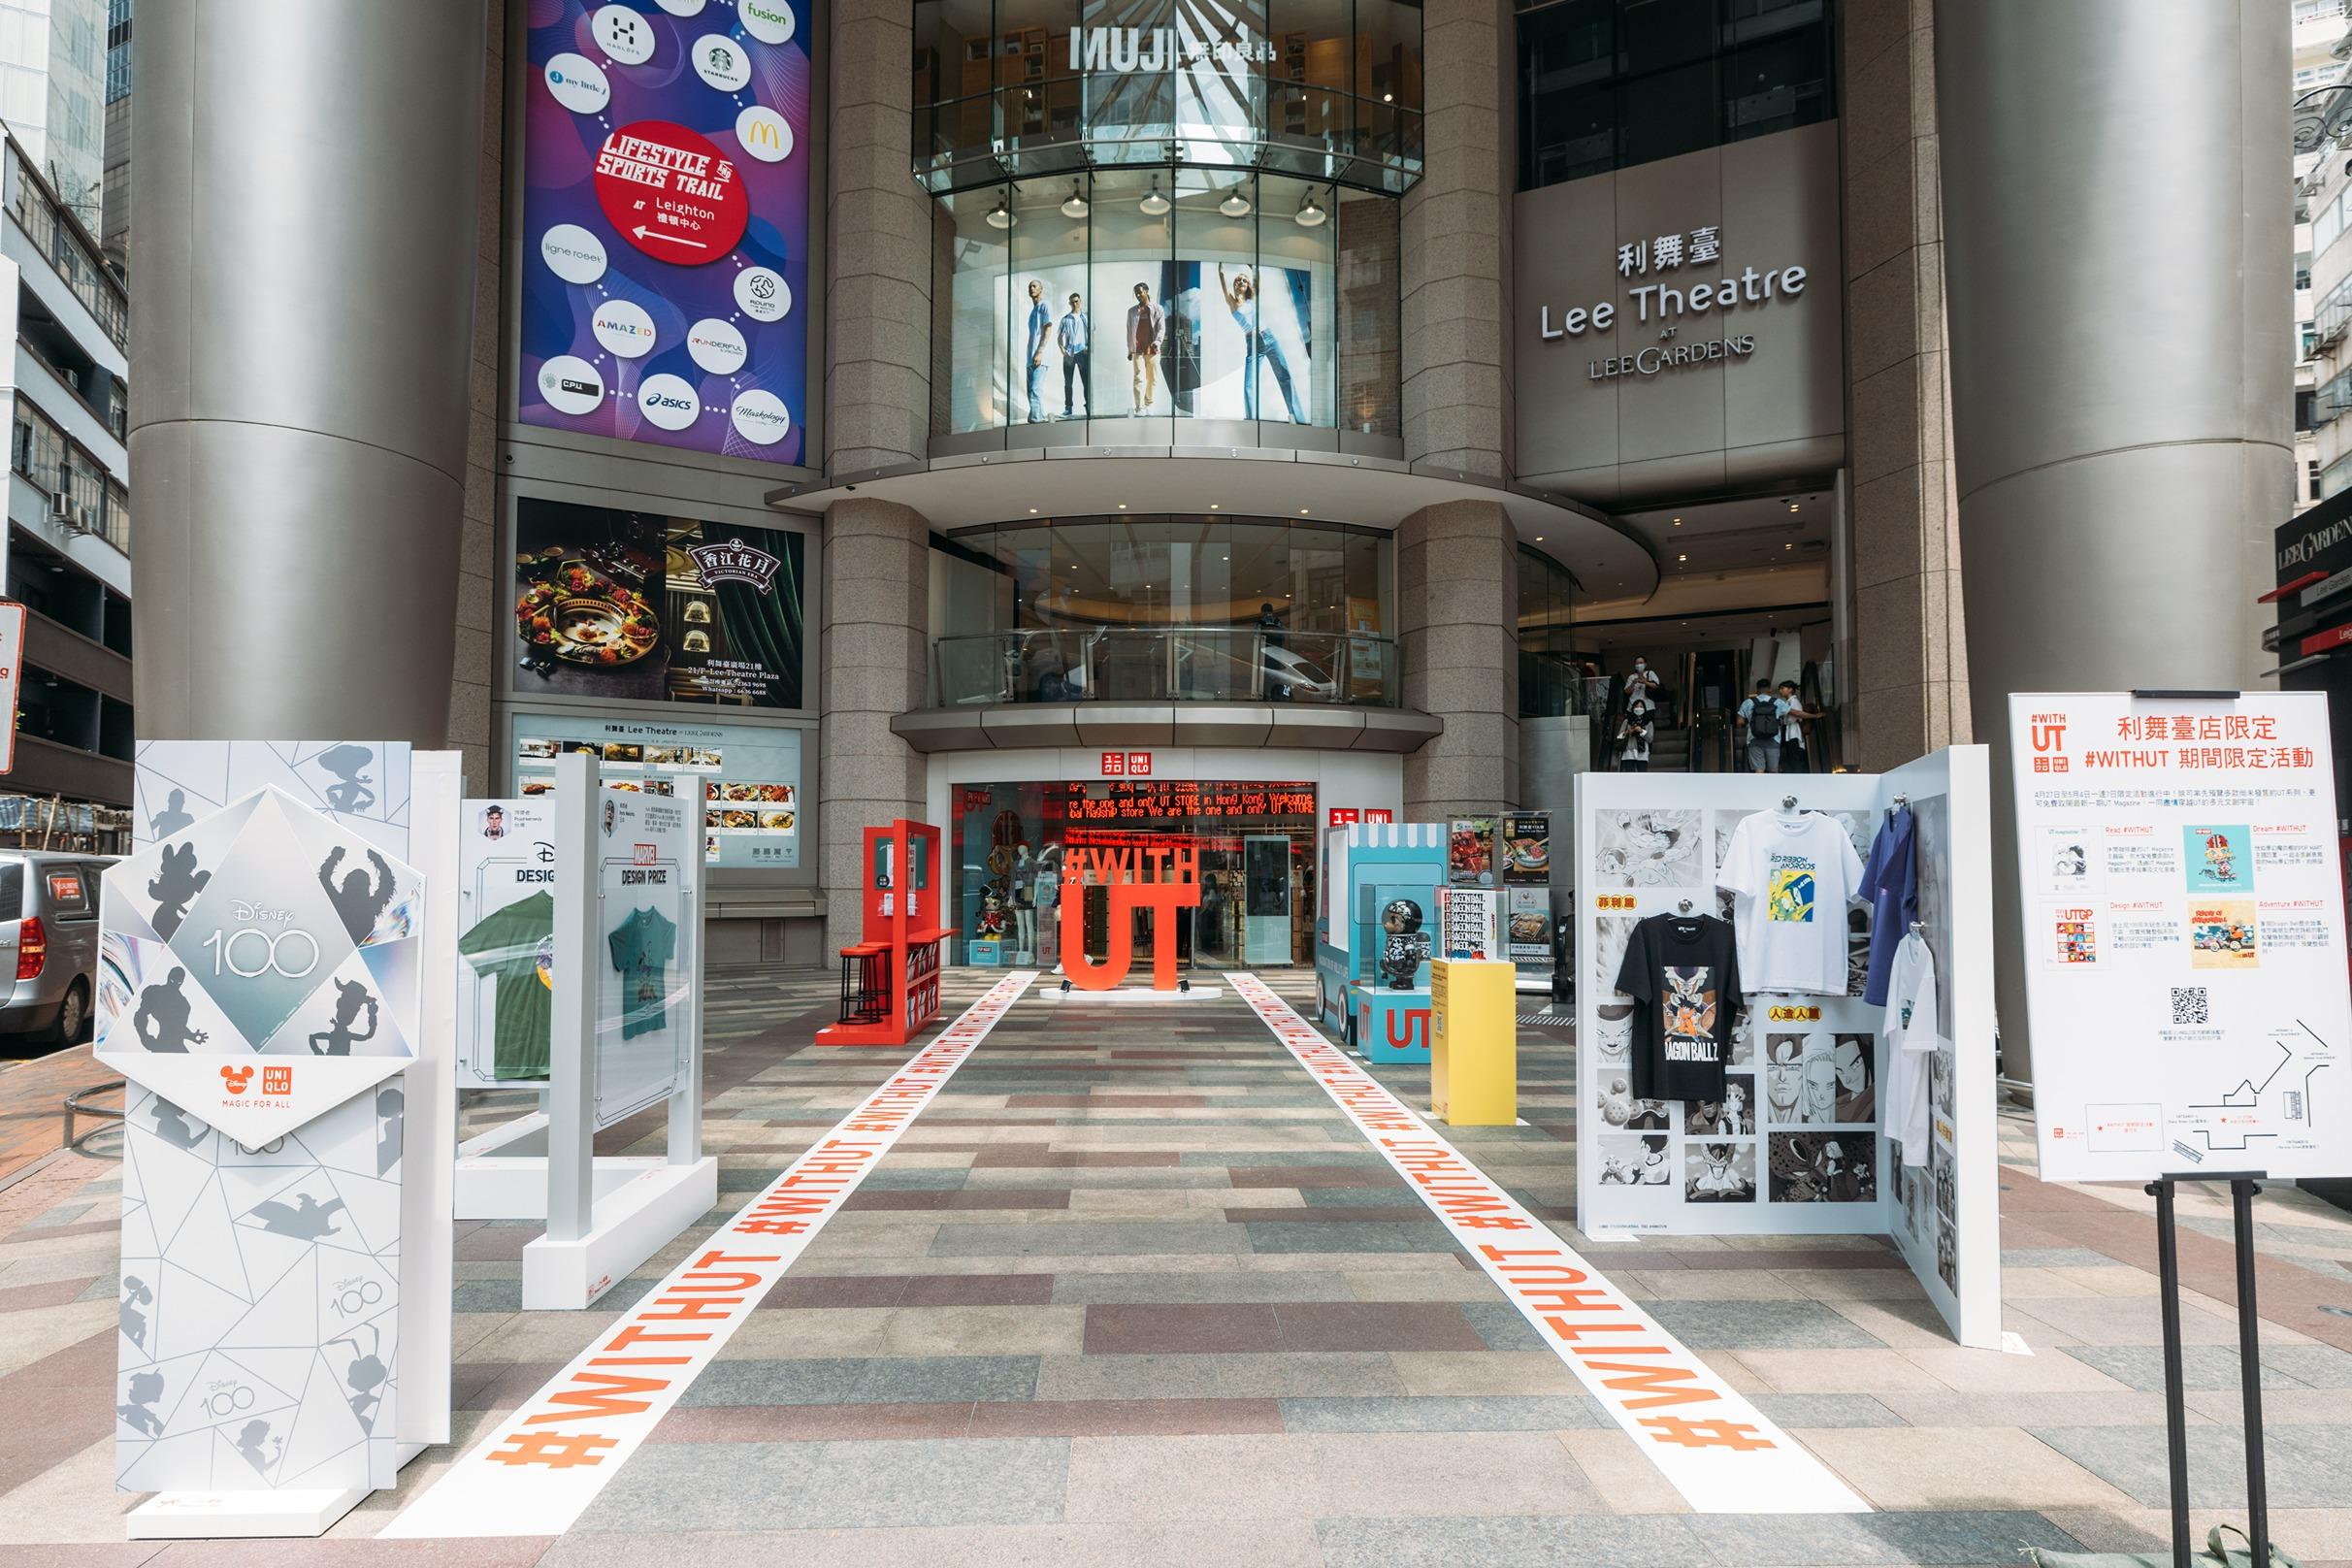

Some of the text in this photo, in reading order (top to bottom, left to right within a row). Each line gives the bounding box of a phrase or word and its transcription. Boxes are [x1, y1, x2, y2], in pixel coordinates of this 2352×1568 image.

[748, 3, 786, 25] fusion
[1069, 26, 1179, 72] MUJI
[1187, 39, 1276, 62] 無印良品
[580, 81, 600, 93] little
[703, 69, 738, 82] STARBUCKS
[602, 132, 711, 177] LIFESTYLE
[596, 153, 724, 202] SPORTS TRAIL
[634, 197, 715, 220] AT Leighton
[544, 244, 572, 257] ligne
[1617, 225, 1720, 277] 利舞臺
[1541, 264, 1807, 340] Lee Theatre
[692, 338, 743, 351] RUNDERFUL
[1659, 327, 1677, 341] AT
[735, 406, 785, 424] Maskology
[702, 551, 768, 573] 香江花月
[727, 670, 757, 678] Theatre
[759, 671, 779, 680] Plaza
[2032, 713, 2066, 724] #WITH
[2117, 715, 2277, 740] 利舞臺店限定
[645, 727, 677, 735] Theatre
[2032, 726, 2066, 752] UT
[2085, 746, 2313, 769] #WITHUT 期間限定活動
[1118, 797, 1134, 808] and
[1160, 795, 1171, 806] UT
[1174, 794, 1199, 806] STORE
[1216, 794, 1237, 805] Hong
[1242, 793, 1264, 804] Kong
[1268, 792, 1312, 803] Welcome
[1121, 806, 1144, 817] store
[1166, 807, 1182, 816] are
[1186, 805, 1201, 815] the
[1205, 806, 1222, 815] one
[1225, 804, 1242, 815] and
[1270, 802, 1282, 814] UT
[1287, 801, 1315, 814] STORE
[1367, 812, 1388, 824] UNI
[635, 845, 656, 866] MARVEL
[1064, 848, 1199, 884] #WITH
[622, 870, 667, 885] DESIGN PRIZE
[2065, 909, 2093, 920] UTGP
[1062, 884, 1201, 991] UT
[202, 929, 319, 978] 100
[1388, 1009, 1432, 1048] UT
[905, 1039, 974, 1073] #WITHUT
[1288, 1040, 1358, 1074] #WITHUT
[1691, 1042, 1714, 1062] BALL
[1714, 1042, 1719, 1062] Z
[266, 1070, 287, 1080] UNI
[265, 1082, 288, 1093] QLO
[843, 1078, 938, 1131] #WITHUT
[1323, 1079, 1421, 1130] #WITHUT
[732, 1139, 883, 1235] #WITHUT
[1379, 1138, 1534, 1230] #WITHUT
[330, 1280, 383, 1319] 100
[485, 1251, 781, 1468] #WITHUT
[1478, 1244, 1778, 1452] #WITHUT
[200, 1386, 255, 1419] 100
